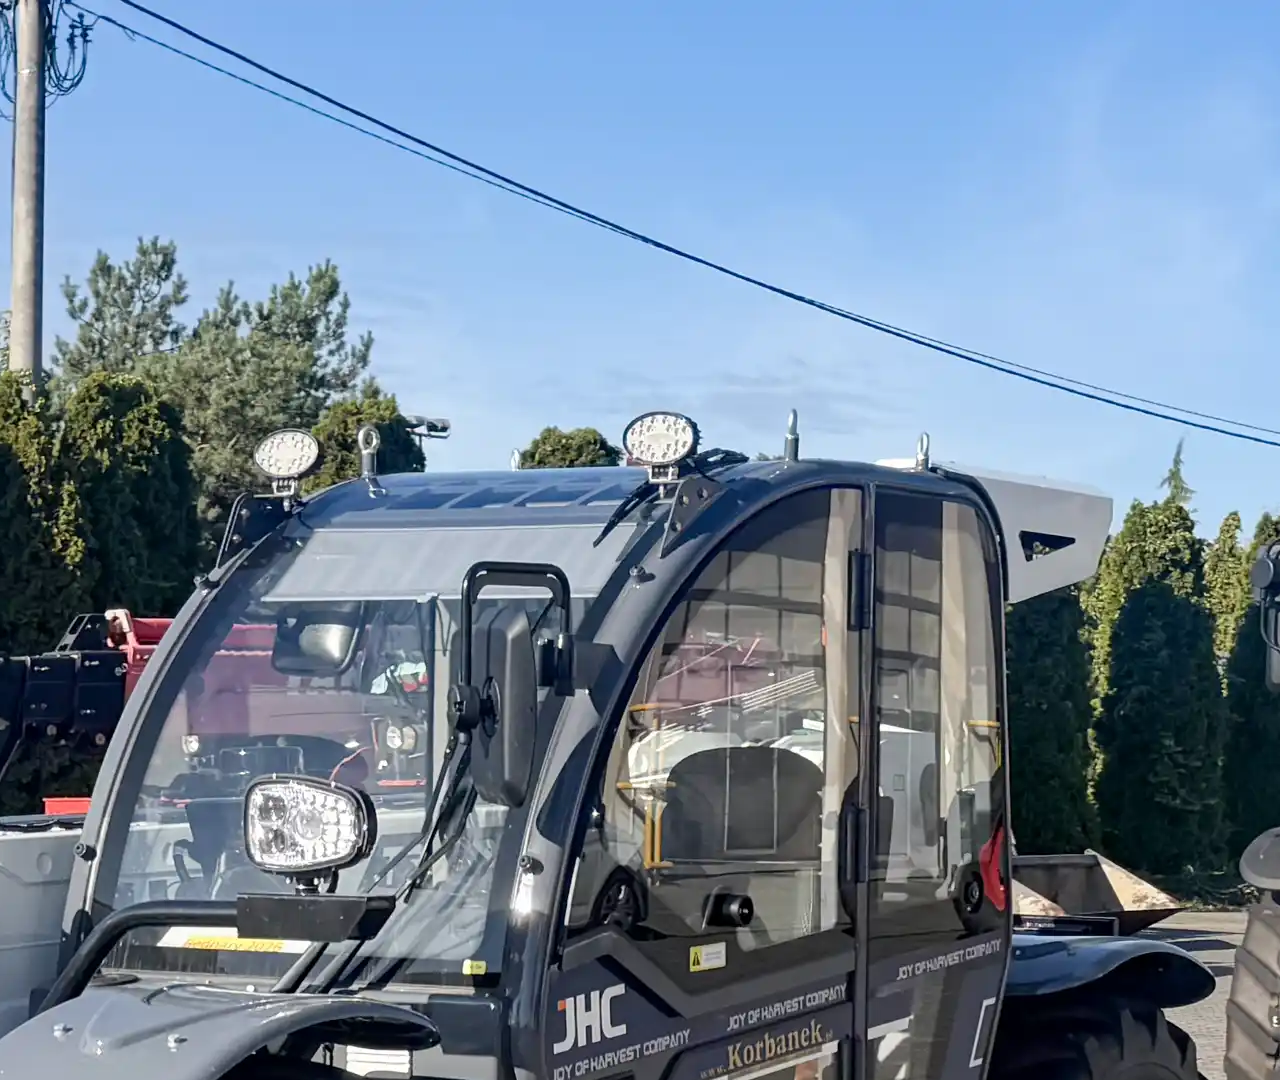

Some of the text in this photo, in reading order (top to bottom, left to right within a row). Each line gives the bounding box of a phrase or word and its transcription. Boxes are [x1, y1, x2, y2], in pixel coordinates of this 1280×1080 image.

[897, 964, 914, 980] JOY
[926, 949, 965, 973] HARVEST
[965, 938, 1001, 960] COMPANY
[553, 983, 626, 1055] JHC
[726, 983, 847, 1031] JOY OF HARVEST COMPANY
[574, 1060, 591, 1077] OF
[590, 1043, 642, 1073] HARVEST
[642, 1028, 692, 1056] COMPANY
